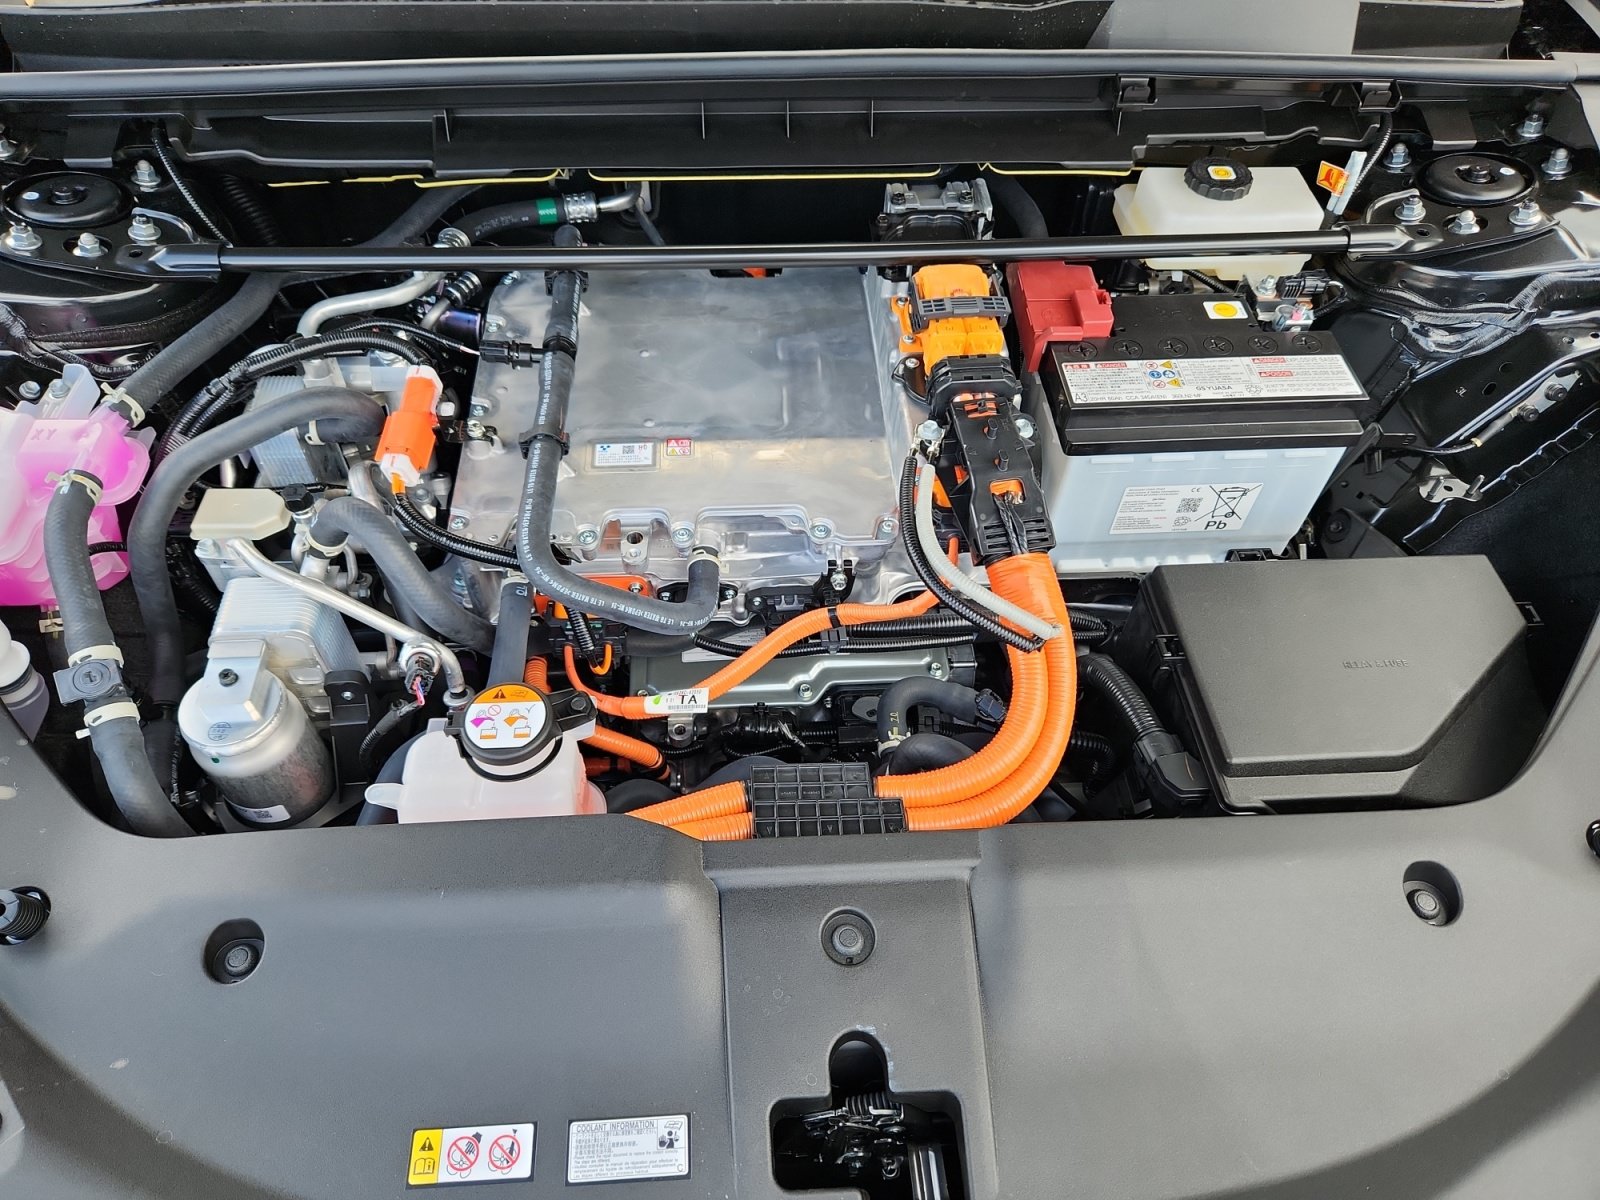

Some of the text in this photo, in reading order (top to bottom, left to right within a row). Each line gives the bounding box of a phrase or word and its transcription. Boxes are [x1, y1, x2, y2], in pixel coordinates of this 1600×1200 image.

[1076, 392, 1088, 402] A3
[1204, 520, 1227, 530] Pb
[572, 591, 589, 603] WATER
[643, 611, 660, 622] WATER
[679, 695, 697, 704] TA
[576, 1120, 654, 1133] COOLANT INFORMATION
[677, 1164, 684, 1172] C
